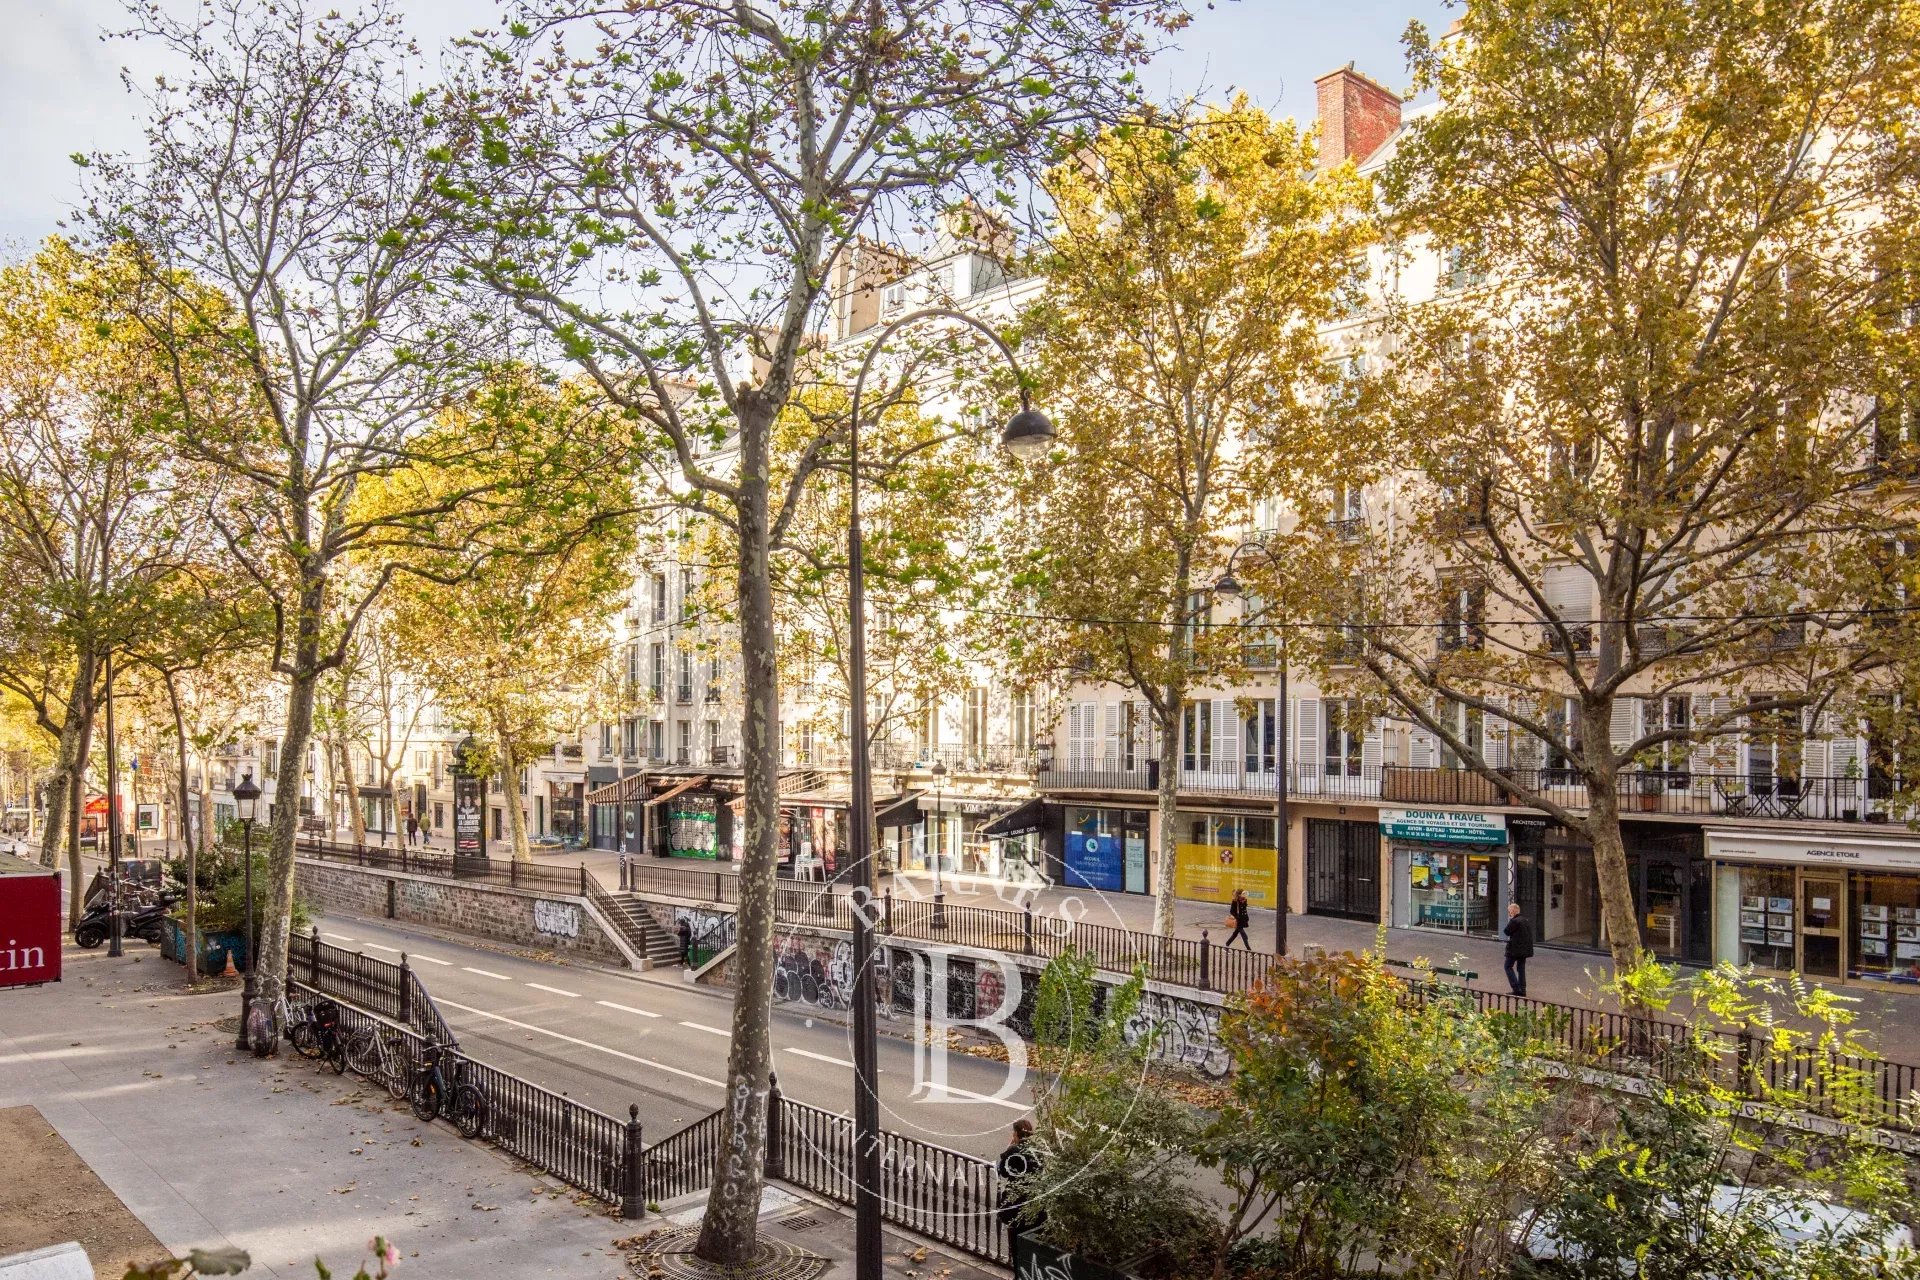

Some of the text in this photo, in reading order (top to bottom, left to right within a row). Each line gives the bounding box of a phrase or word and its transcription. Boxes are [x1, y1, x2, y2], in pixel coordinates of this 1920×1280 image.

[1406, 810, 1487, 822] DOUNYA TRAVEL
[1836, 851, 1860, 859] ETOILE
